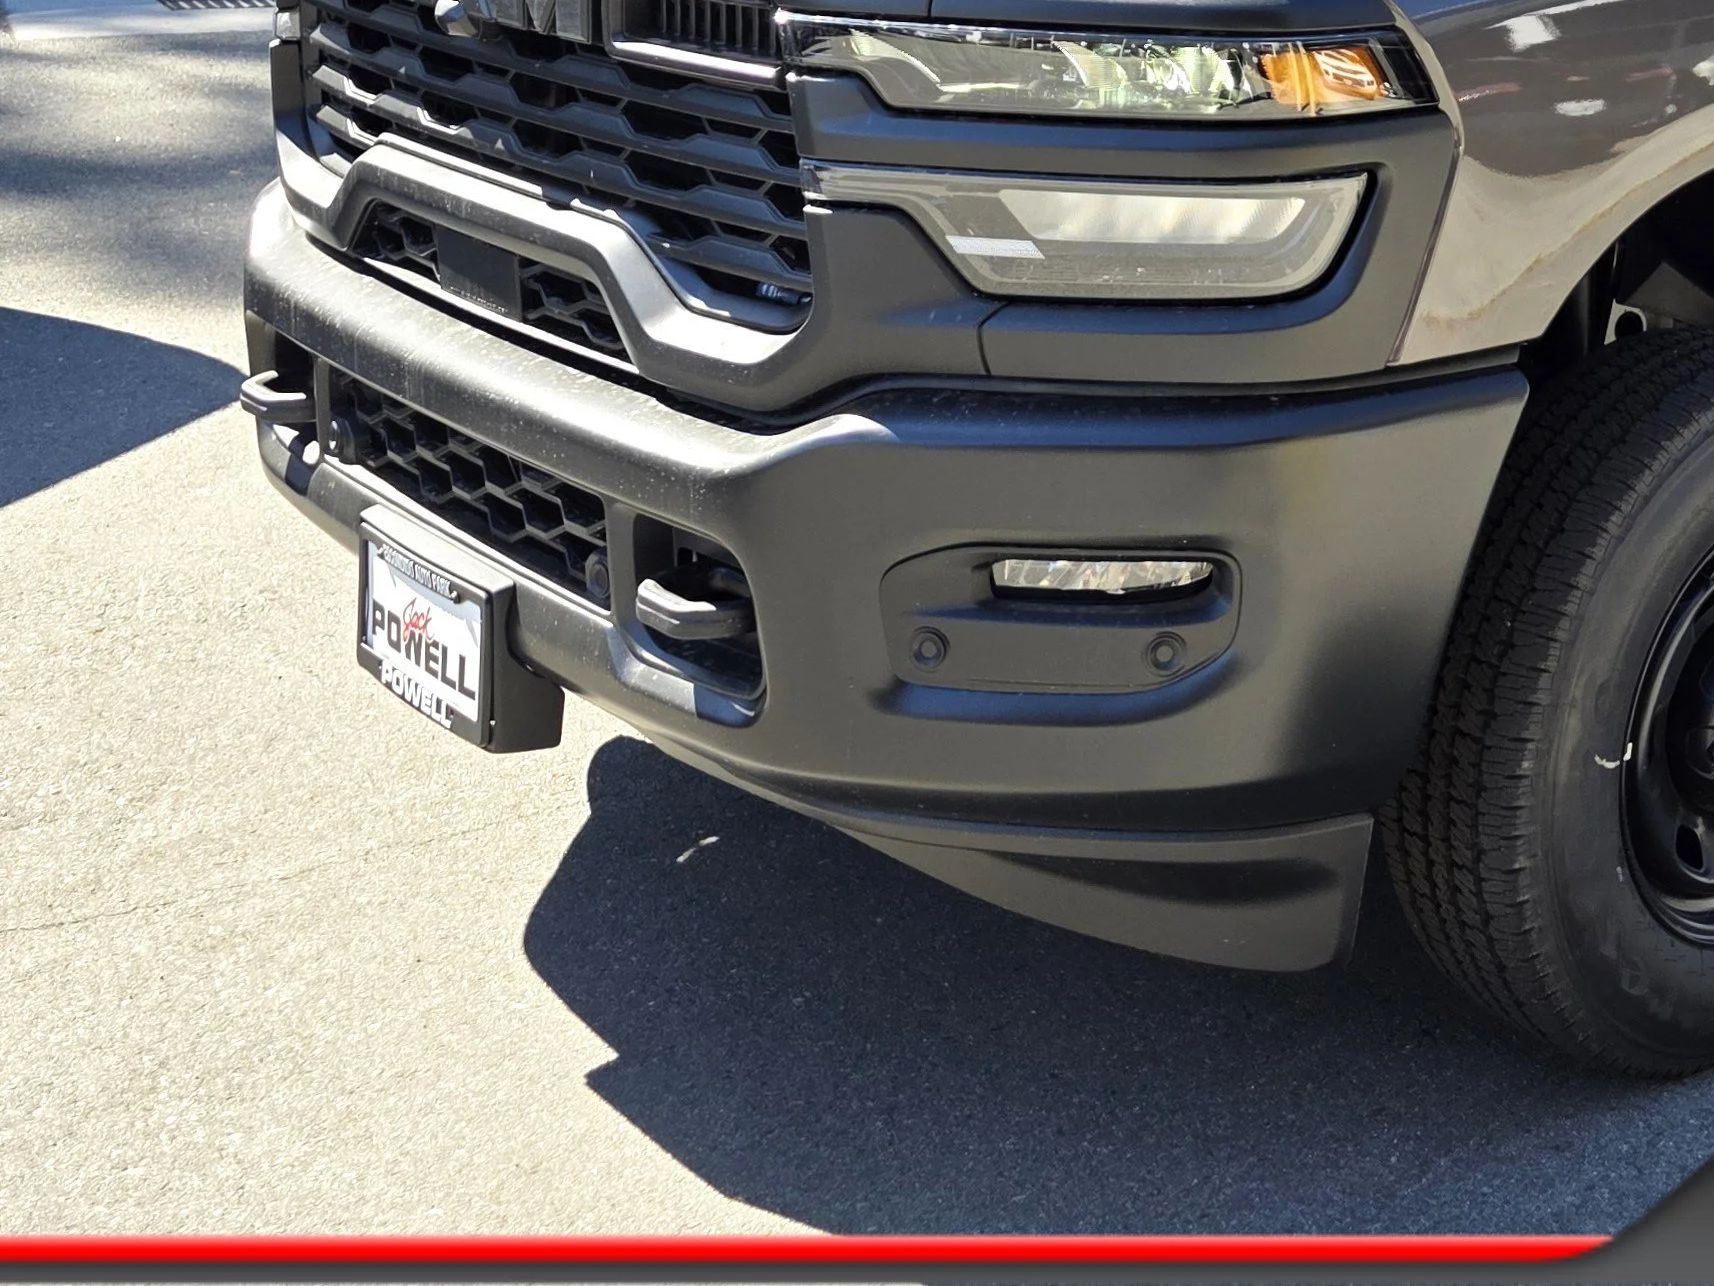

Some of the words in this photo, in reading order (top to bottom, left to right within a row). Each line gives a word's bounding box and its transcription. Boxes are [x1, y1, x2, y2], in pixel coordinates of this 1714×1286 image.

[372, 598, 476, 702] POWELL
[403, 597, 435, 642] Jack
[381, 657, 453, 730] POWELL
